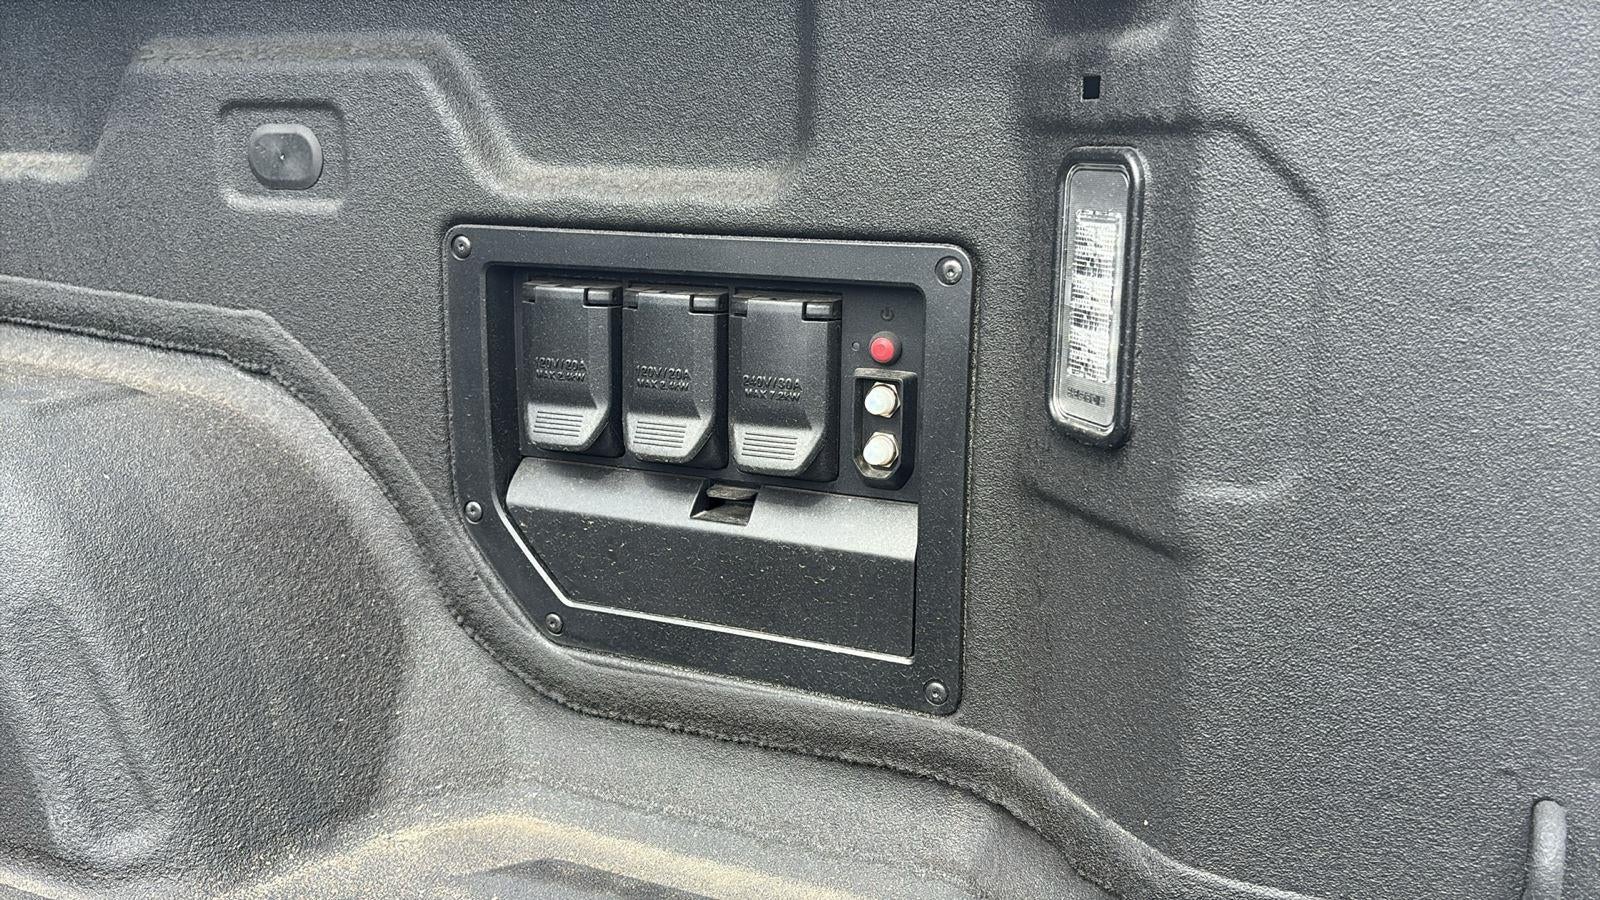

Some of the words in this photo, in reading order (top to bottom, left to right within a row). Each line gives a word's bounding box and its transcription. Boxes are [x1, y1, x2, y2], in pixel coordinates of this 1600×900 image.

[535, 356, 587, 372] 120V/20A
[536, 368, 556, 380] MAX
[637, 365, 691, 380] 120V/20A
[637, 378, 658, 389] MAX
[743, 374, 803, 391] 240V/30A
[744, 388, 768, 400] MAX
